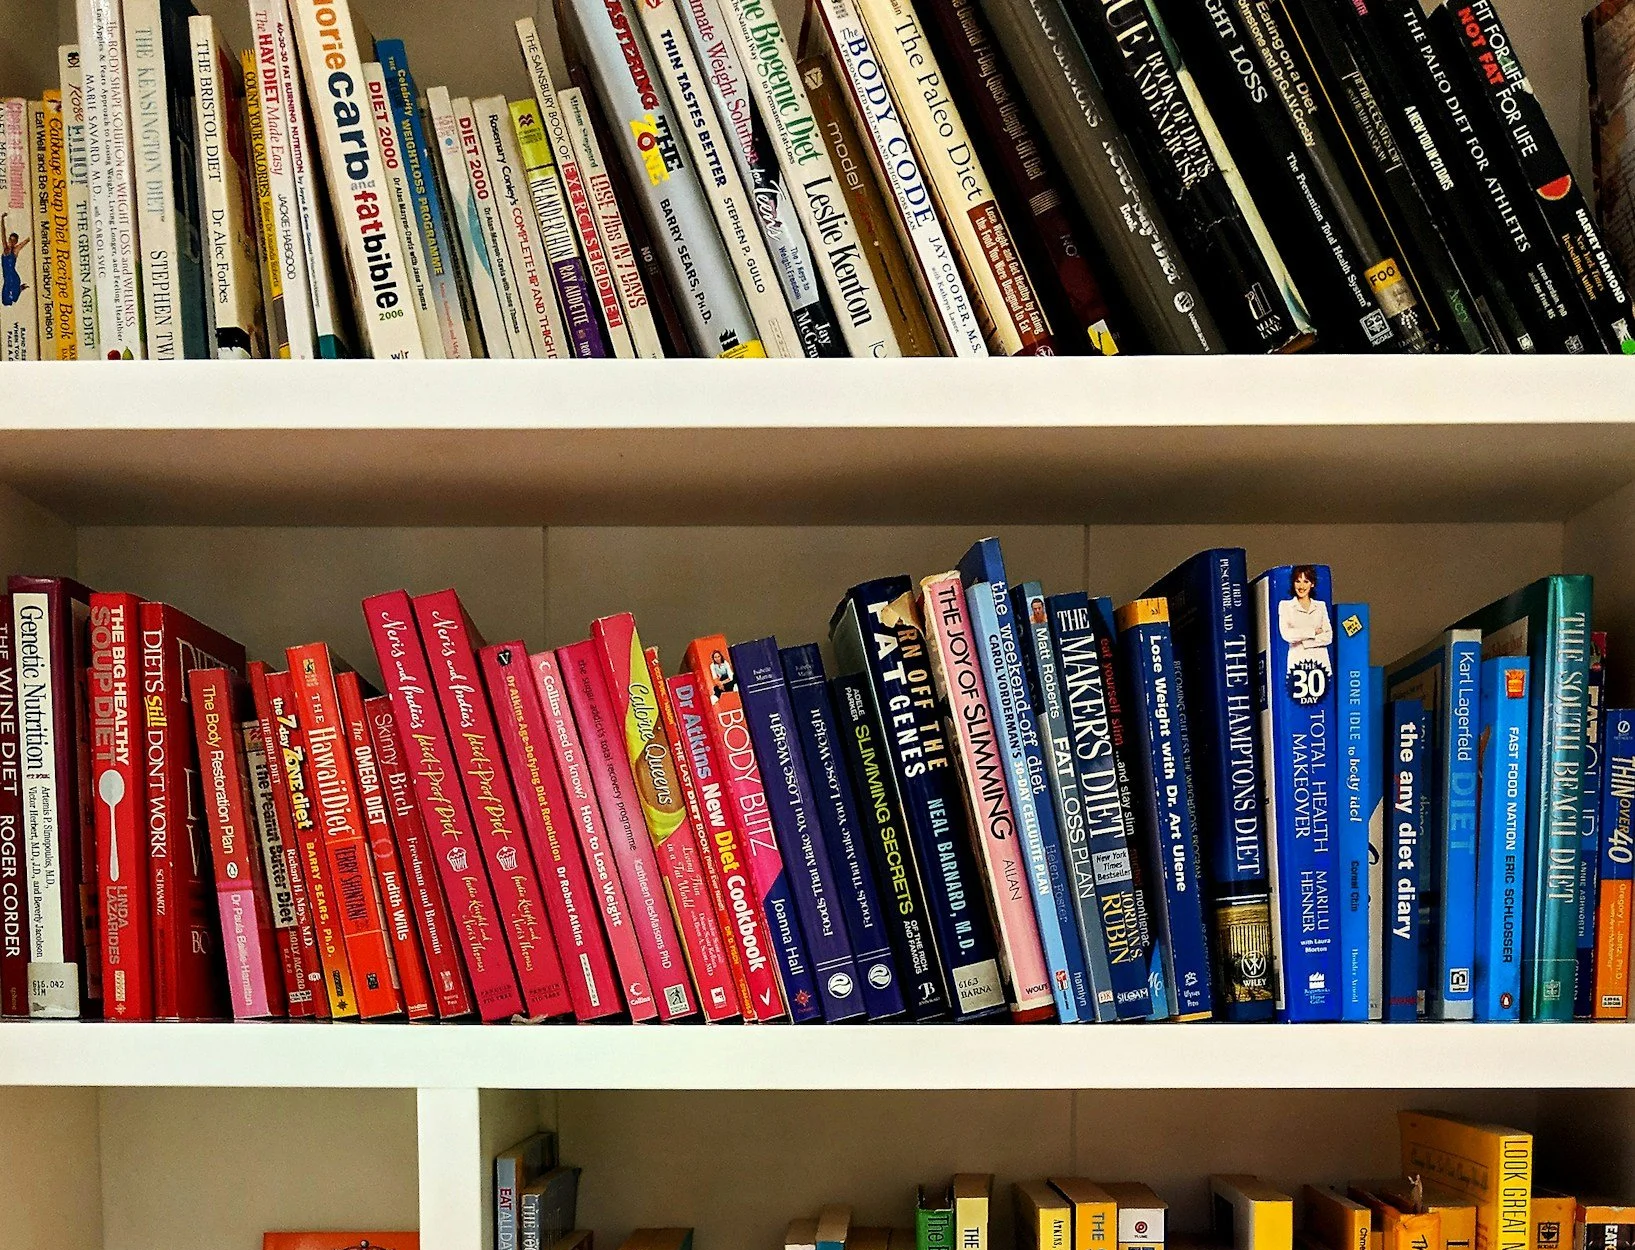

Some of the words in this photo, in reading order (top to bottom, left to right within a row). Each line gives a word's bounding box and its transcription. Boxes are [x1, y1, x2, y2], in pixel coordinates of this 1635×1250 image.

[197, 40, 211, 76] THE
[200, 78, 218, 143] BRISTOL
[369, 81, 386, 121] DIET
[380, 124, 398, 169] 2000
[660, 29, 683, 70] THIN
[677, 72, 706, 129] TASTES
[699, 130, 726, 188] BETTER
[895, 15, 923, 68] The
[917, 72, 953, 137] Paleo
[948, 141, 983, 201] Diet
[1403, 8, 1427, 42] THE
[1421, 45, 1452, 94] PALEO
[1446, 97, 1473, 135] DIET
[1467, 135, 1489, 172] FOR
[1485, 176, 1532, 254] ATHLETES
[206, 145, 222, 182] DIET
[211, 209, 225, 227] Dr
[214, 231, 227, 258] Alec
[803, 175, 849, 245] Leslie
[829, 243, 873, 328] Kenton
[1575, 208, 1601, 250] HARVEY
[1596, 251, 1626, 304] DIAMOND
[216, 261, 229, 304] Forbes
[379, 309, 404, 321] 2006
[20, 605, 42, 679] Genetic
[110, 605, 125, 642] THE
[1057, 608, 1088, 630] THE
[112, 645, 126, 680] BIG
[1224, 635, 1247, 687] THE
[1060, 635, 1112, 760] MAKER'S
[24, 683, 45, 769] Nutrition
[113, 683, 129, 766] HEALTHY
[1399, 721, 1417, 763] the
[1509, 726, 1520, 759] FAST
[375, 713, 398, 768] Skinny
[389, 773, 410, 817] Bitch
[1227, 695, 1256, 811] HAMPTONS
[719, 707, 761, 786] BODY
[741, 793, 777, 857] BLITZ
[1080, 770, 1125, 840] DIET
[1395, 770, 1416, 814] any
[1507, 763, 1519, 798] FOOD
[855, 725, 890, 824] SLIMMING
[881, 827, 913, 915] SECRETS
[1505, 802, 1518, 851] NATION
[1235, 816, 1260, 875] DIET
[1398, 822, 1417, 871] diet
[1504, 855, 1516, 883] ERIC
[701, 782, 725, 828] New
[715, 831, 739, 874] Diet
[727, 874, 764, 973] Cookbook
[1393, 878, 1416, 940] diary
[1503, 887, 1515, 964] SCHLOSSER
[32, 980, 65, 991] 616.042
[1502, 1140, 1530, 1180] LOOK
[1092, 1213, 1105, 1242] THE
[1501, 1187, 1528, 1234] GREAT
[964, 1227, 979, 1248] THE
